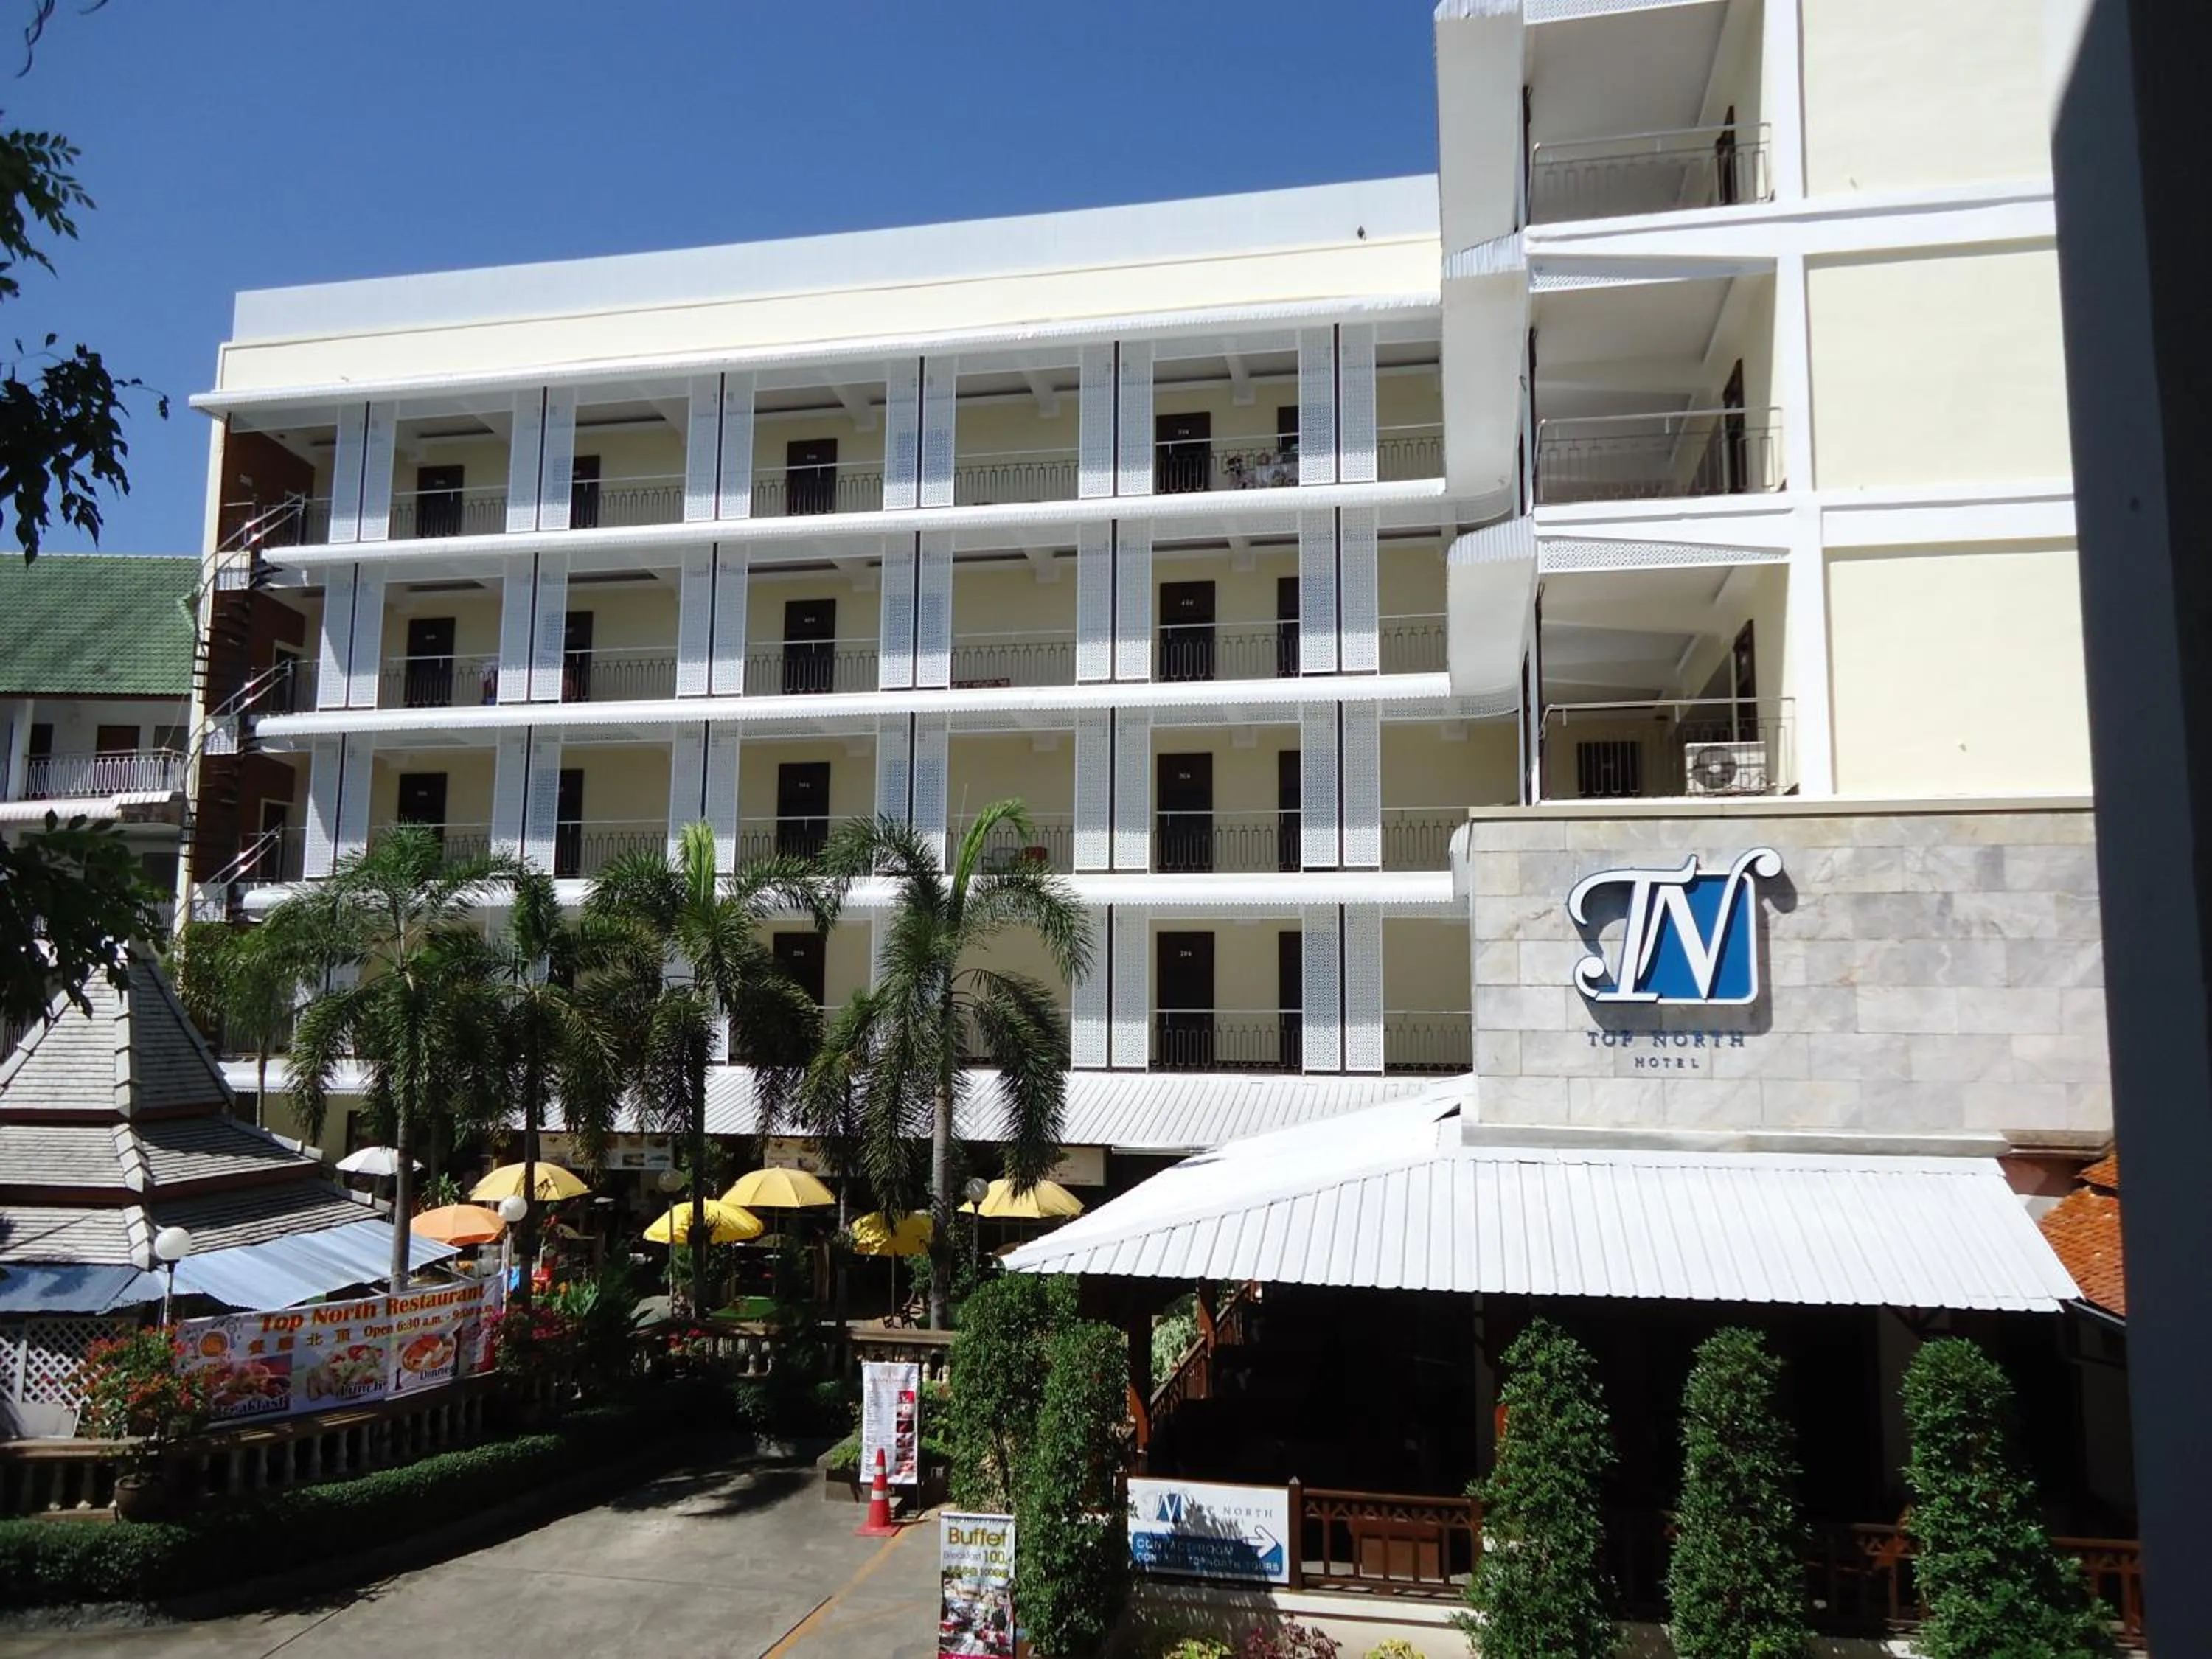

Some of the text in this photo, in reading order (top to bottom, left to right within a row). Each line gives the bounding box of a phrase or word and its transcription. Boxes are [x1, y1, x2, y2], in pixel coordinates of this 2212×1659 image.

[1587, 1031, 1745, 1048] TOP NORTH
[1635, 1057, 1700, 1069] HOTEL
[262, 1284, 485, 1334] Top North Restaurant
[364, 1324, 393, 1339] Open
[397, 1317, 420, 1332] 6:30
[1223, 1506, 1273, 1518] NORTH
[948, 1527, 1006, 1546] Buffet
